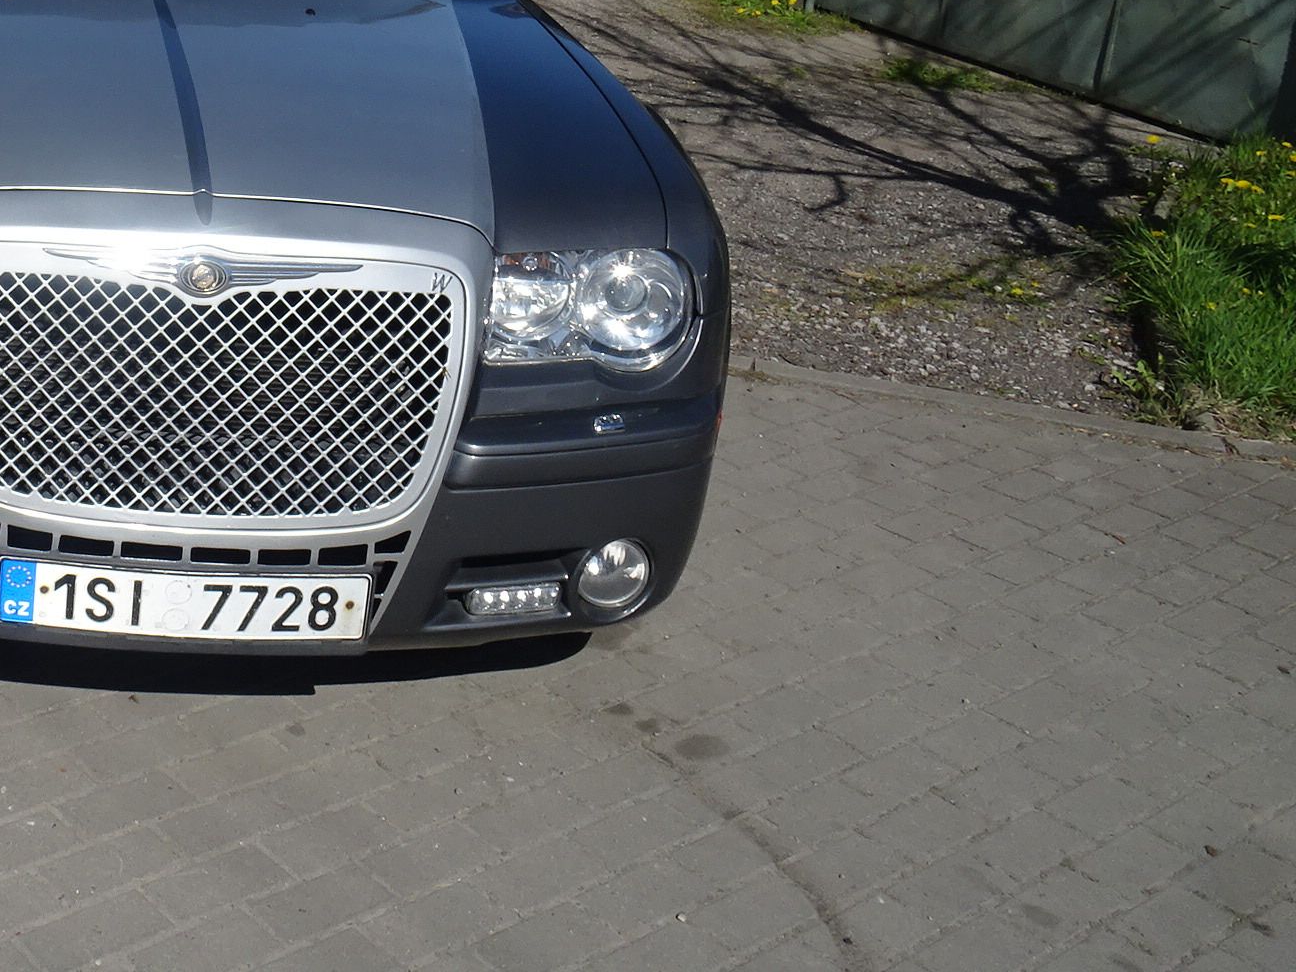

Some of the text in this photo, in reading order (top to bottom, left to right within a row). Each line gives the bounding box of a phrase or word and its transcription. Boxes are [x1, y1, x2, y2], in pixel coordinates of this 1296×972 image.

[3, 598, 31, 617] CZ
[54, 573, 340, 633] 1SI 7728
